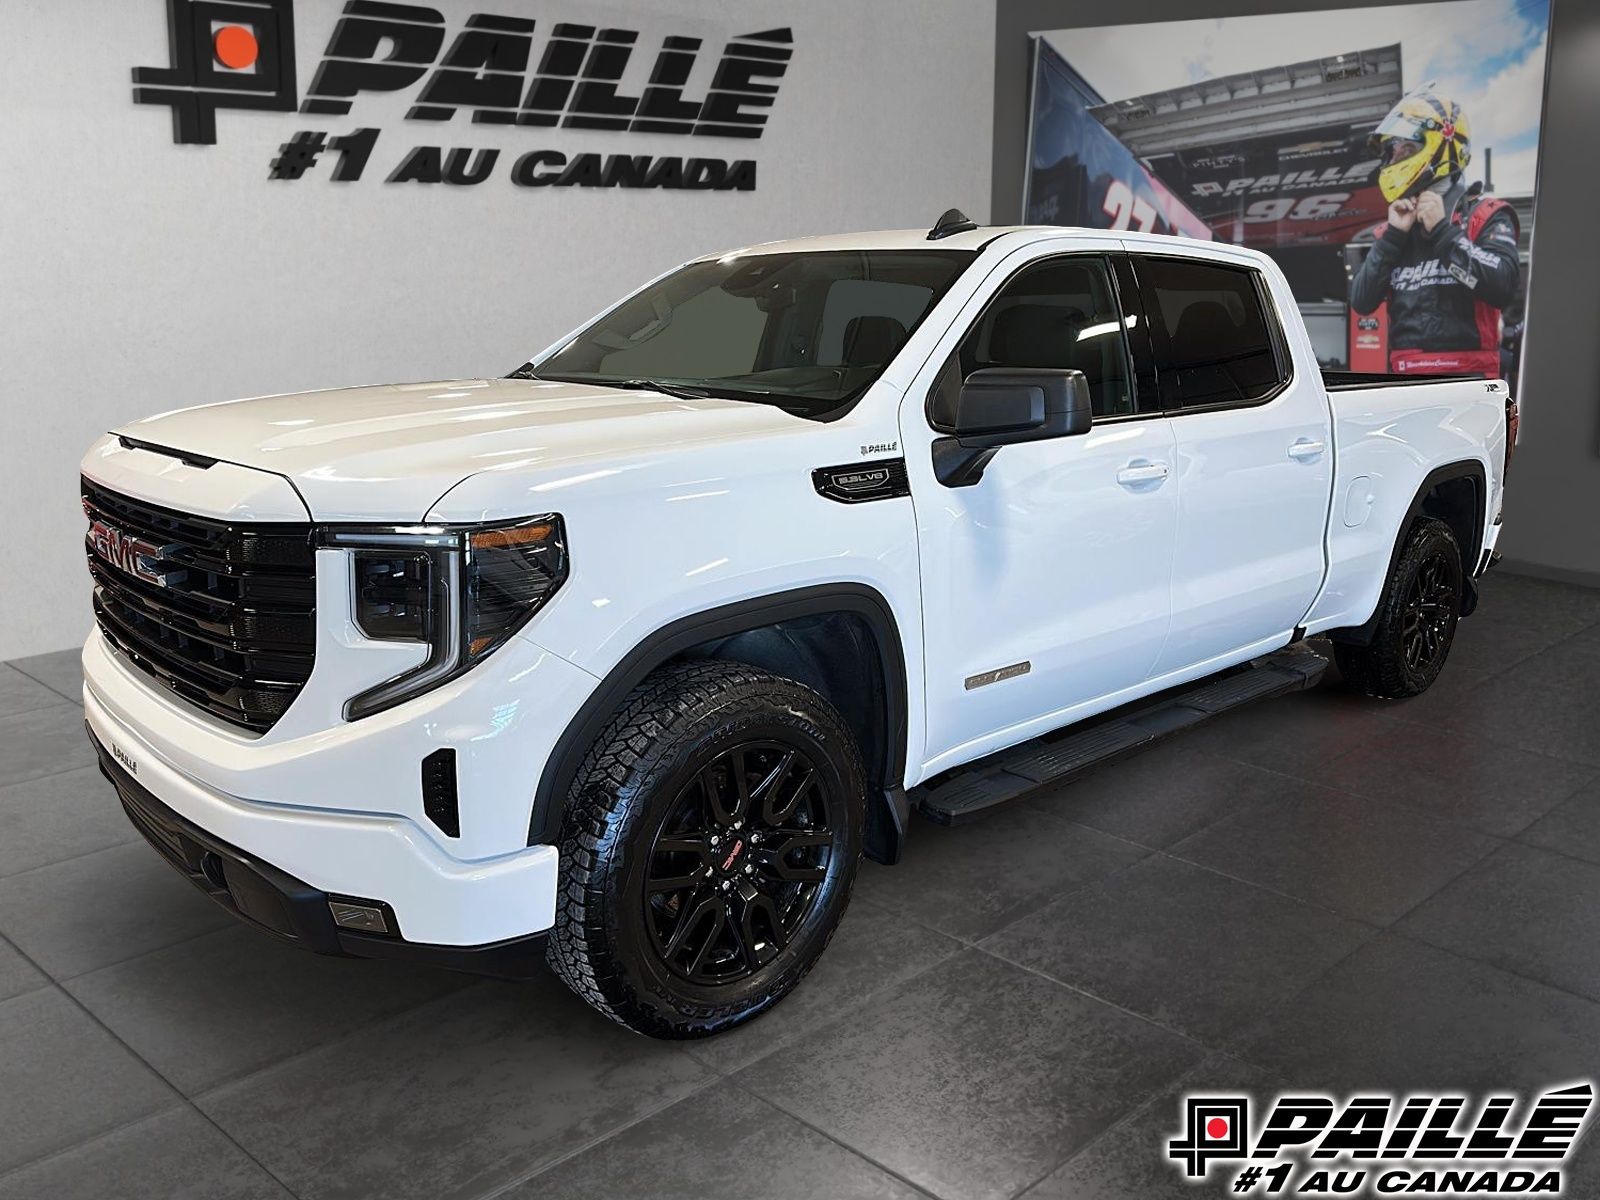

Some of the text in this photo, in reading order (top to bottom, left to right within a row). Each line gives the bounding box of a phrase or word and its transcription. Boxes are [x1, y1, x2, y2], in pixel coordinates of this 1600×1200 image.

[299, 0, 793, 139] PAILLÉ
[269, 128, 757, 191] #1 AU CANADA
[1243, 193, 1350, 223] 96
[86, 520, 167, 588] GMC
[722, 839, 742, 870] GMC
